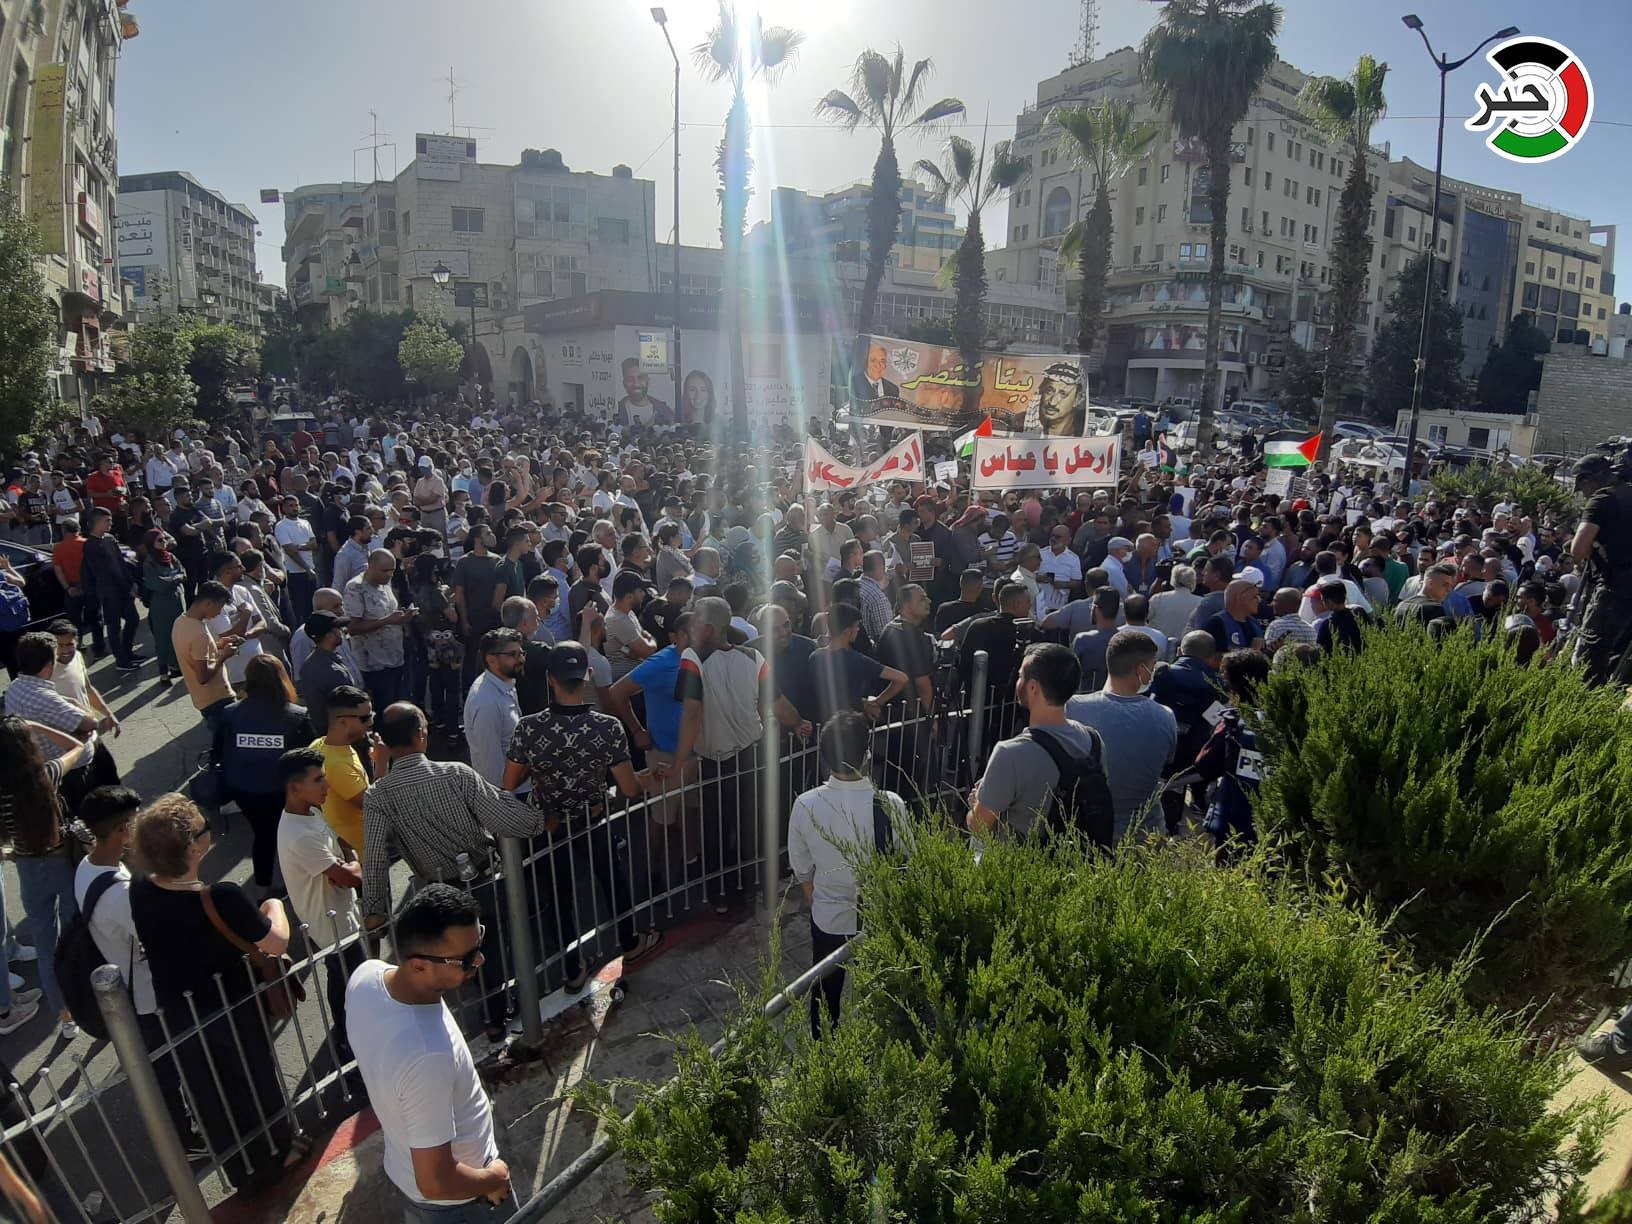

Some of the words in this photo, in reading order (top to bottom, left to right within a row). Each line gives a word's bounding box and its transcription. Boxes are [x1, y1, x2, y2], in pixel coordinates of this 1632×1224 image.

[994, 358, 1034, 403] بيتا
[980, 445, 1036, 477] عباس
[1042, 445, 1058, 475] يا
[239, 735, 282, 747] PRESS
